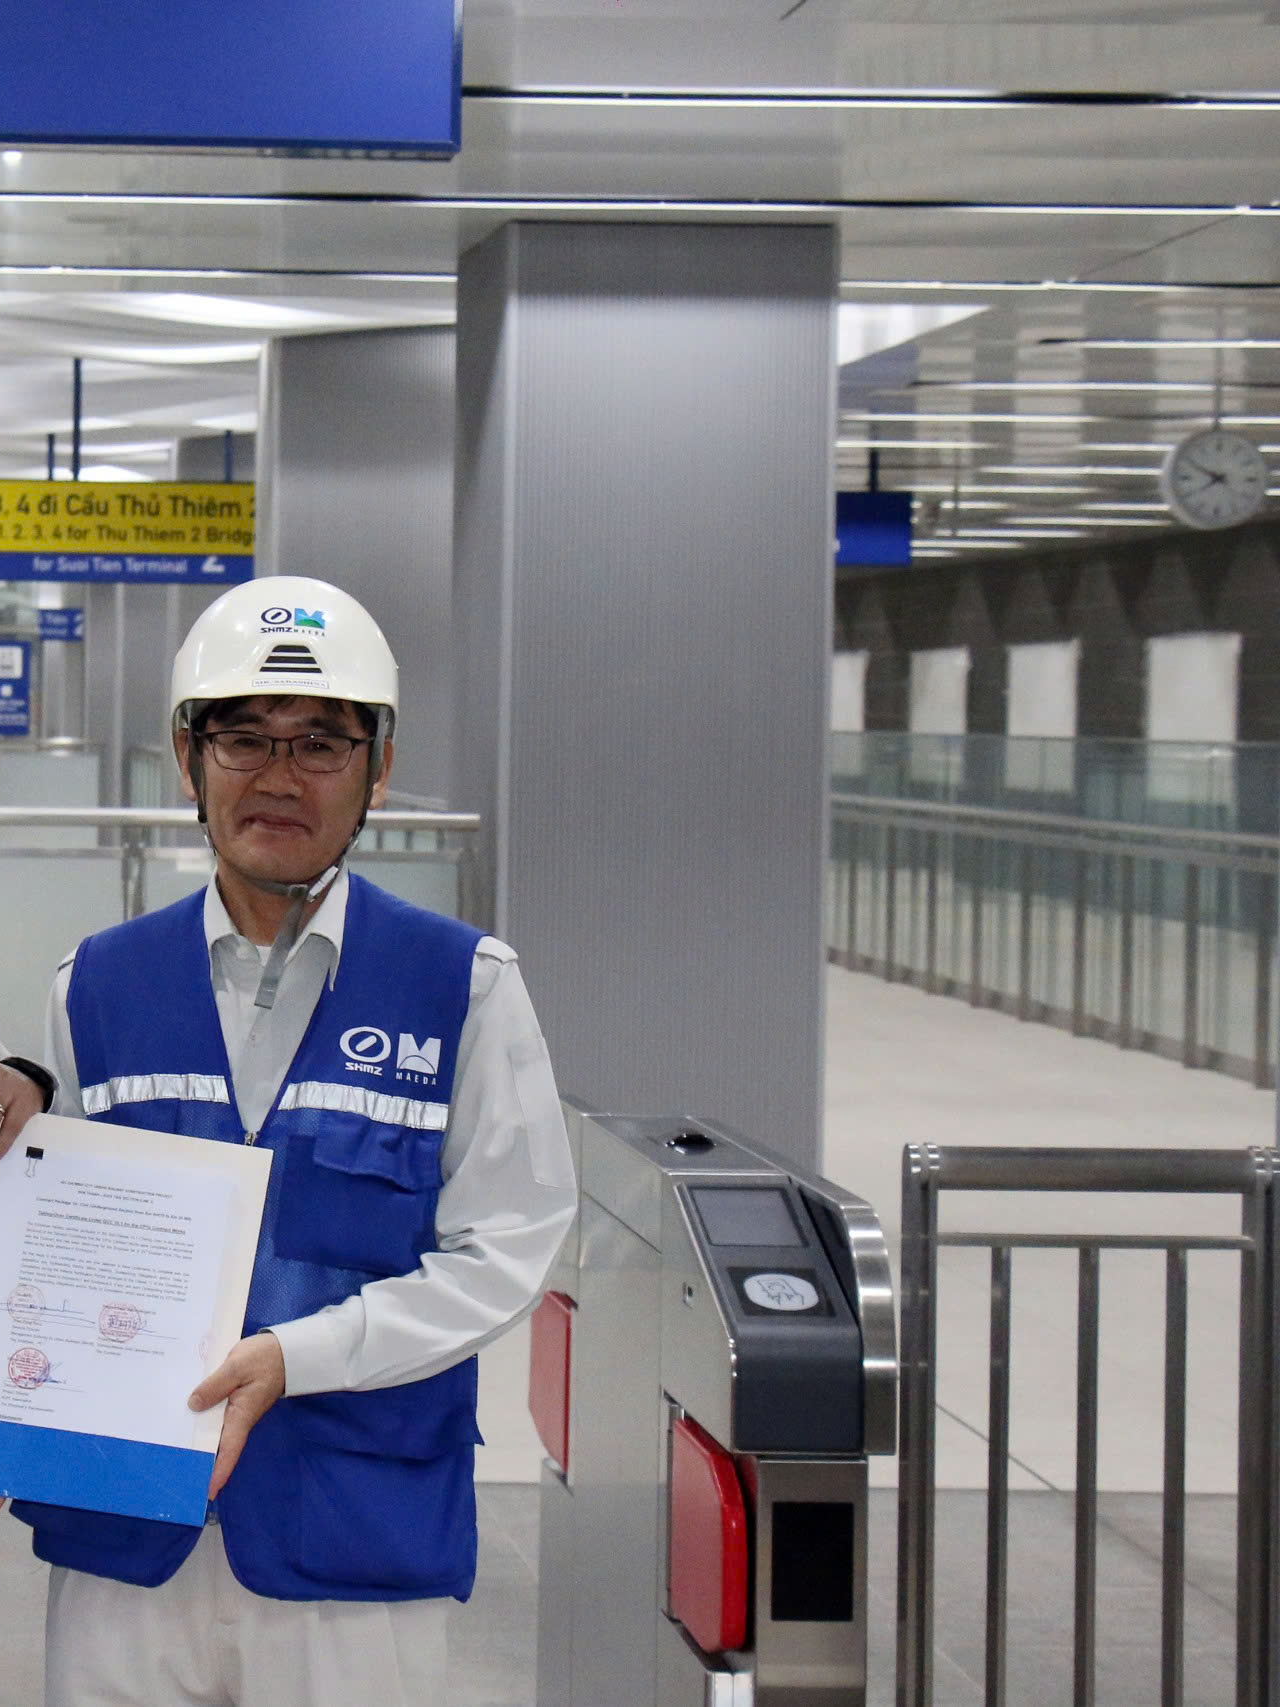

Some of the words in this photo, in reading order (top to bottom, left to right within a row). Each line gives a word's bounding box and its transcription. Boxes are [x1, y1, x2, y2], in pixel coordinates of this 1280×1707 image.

[17, 493, 30, 515] 4
[68, 524, 89, 540] for
[96, 524, 127, 541] Thu
[134, 525, 185, 542] Thiem
[191, 526, 201, 543] 2
[207, 526, 256, 546] Bridg
[344, 1061, 383, 1077] SHMZ
[395, 1071, 438, 1086] MAEDA
